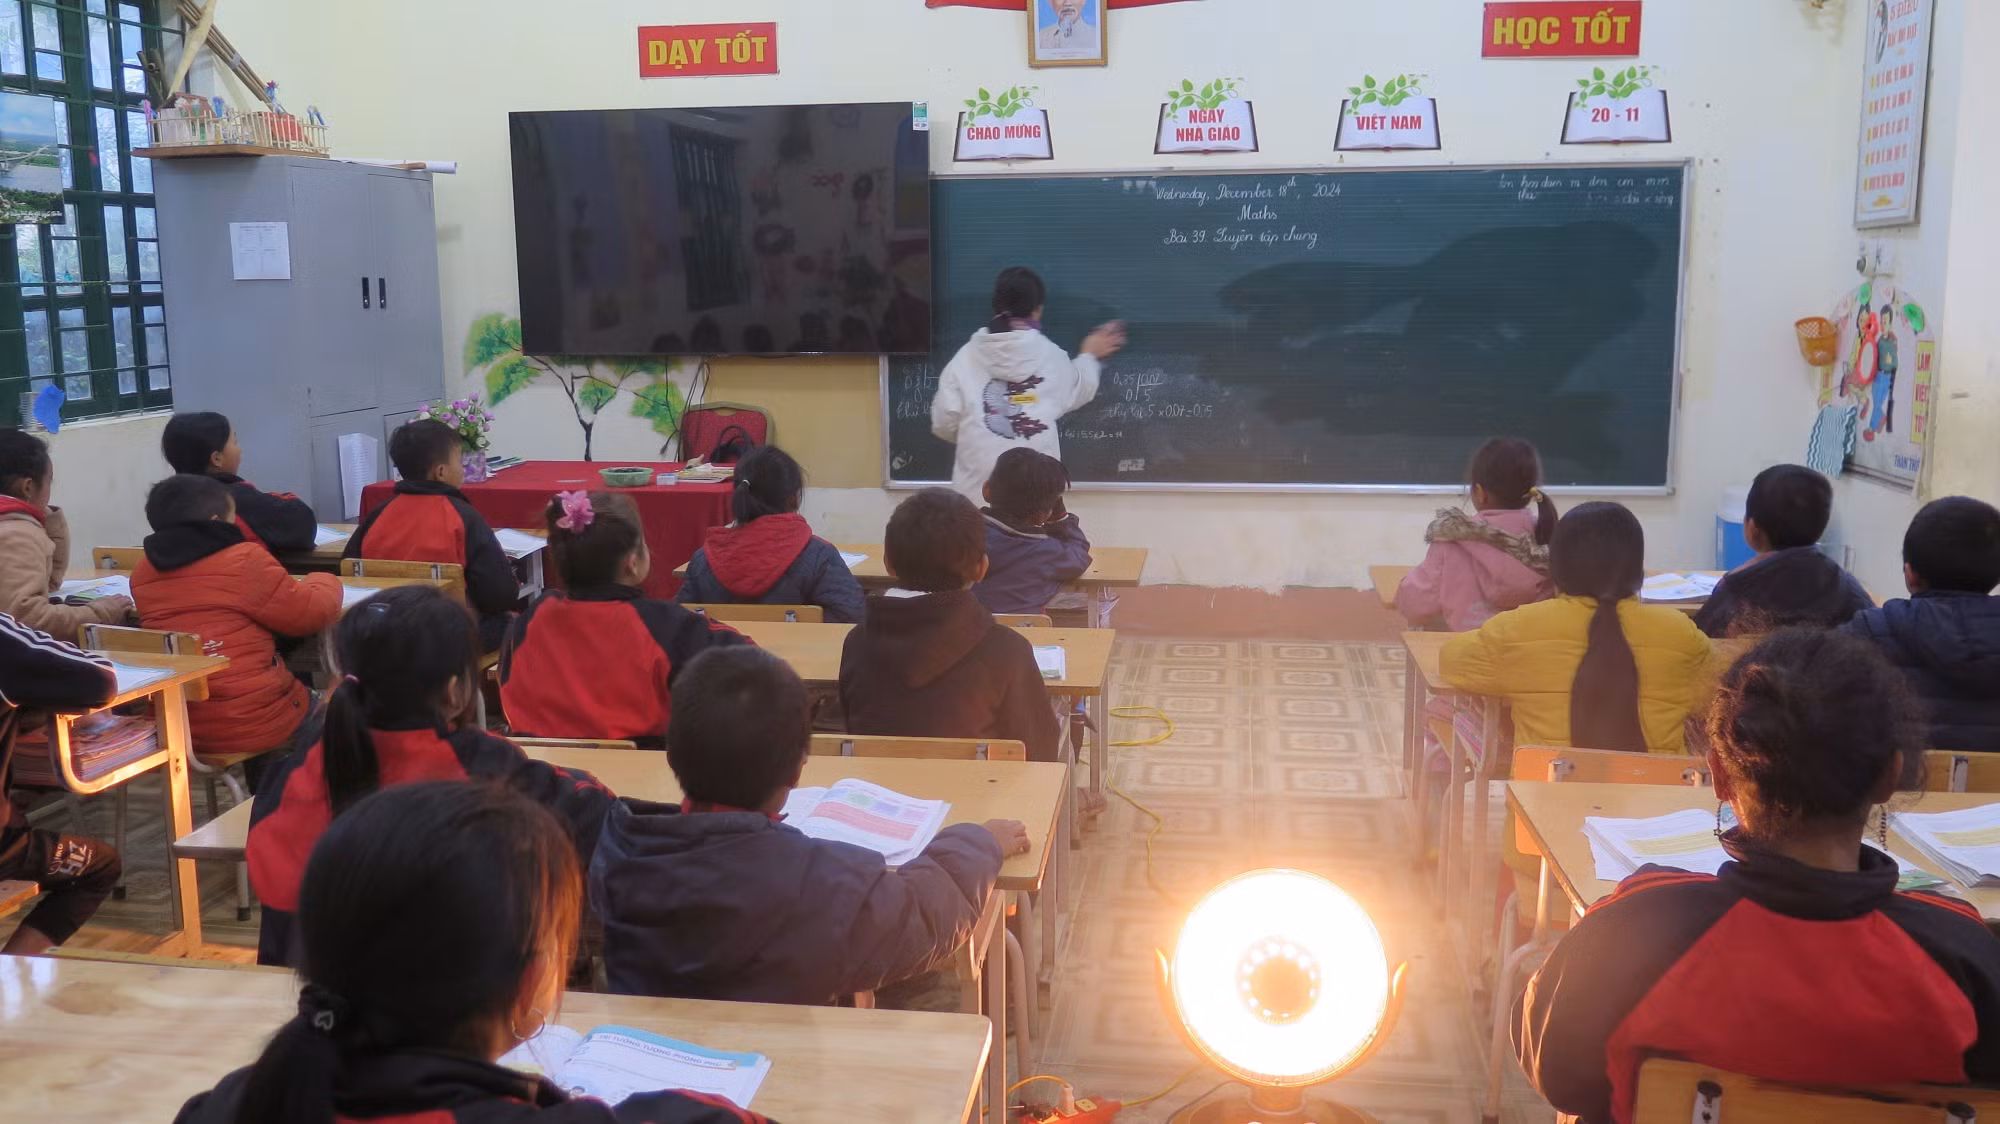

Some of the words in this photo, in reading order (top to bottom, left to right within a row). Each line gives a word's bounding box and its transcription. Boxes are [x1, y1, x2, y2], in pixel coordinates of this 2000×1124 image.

[1493, 16, 1561, 49] HỌC
[1572, 7, 1631, 44] TỐT
[648, 38, 706, 70] DẠY
[714, 29, 768, 64] TỐT
[1356, 113, 1387, 134] VIỆT
[1391, 115, 1422, 130] NAM
[1591, 107, 1610, 122] 20
[1625, 107, 1640, 122] 11
[967, 124, 1000, 140] CHÀO
[1004, 123, 1041, 139] MỪNG
[1175, 124, 1204, 142] NHÀ
[1207, 124, 1241, 142] GIÁO
[1156, 186, 1210, 207] Wednesday,
[1215, 182, 1273, 201] December
[1312, 182, 1341, 198] 2024
[1237, 204, 1278, 222] Maths
[1163, 228, 1188, 245] Bài
[1283, 225, 1318, 250] chung
